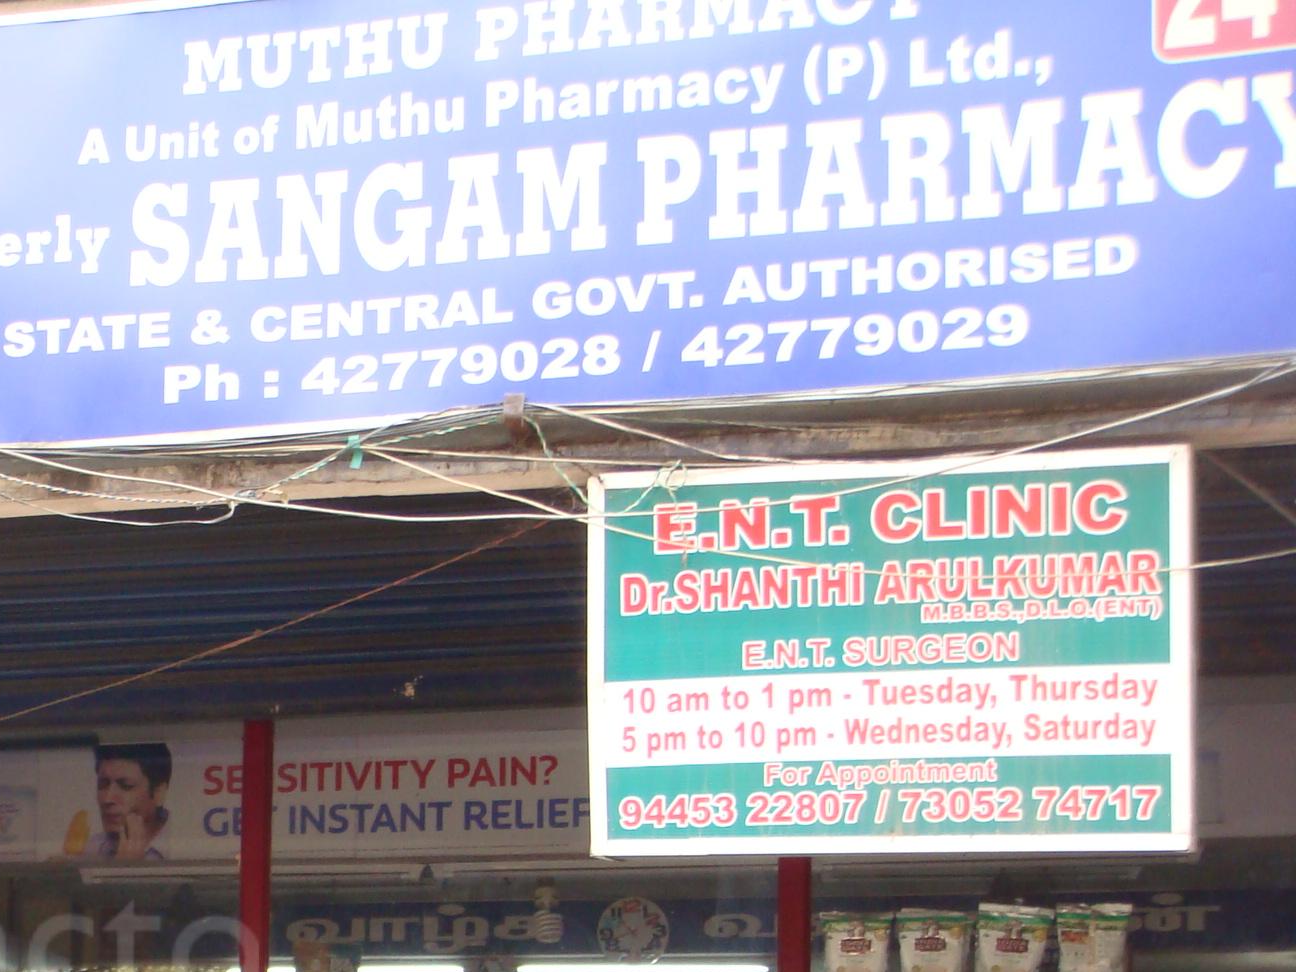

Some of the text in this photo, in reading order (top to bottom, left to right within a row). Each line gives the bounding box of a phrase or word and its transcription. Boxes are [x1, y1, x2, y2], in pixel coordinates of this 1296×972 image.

[182, 10, 448, 96] MUTHU
[78, 29, 1053, 165] A Unit of Muthu Pharmacy (P) Ltd.,
[129, 141, 607, 287] SANGAM
[3, 234, 1139, 358] STATE & CENTRAL GOVT. AUTHORISED
[163, 303, 1031, 404] Ph 42779028 42779029
[654, 480, 1128, 554] E.N.T. CLINIC
[620, 550, 1161, 616] Dr.SHANTHI ARULKUMAR
[742, 632, 1019, 670] E.N.T. SURGEON
[622, 674, 1158, 714] 10 am to 1 pm Tuesday, Thursday
[622, 713, 1157, 758] 5 pm to 10 pm Wednesday, Saturday
[204, 755, 559, 796] SESITIVITY PAIN?
[764, 757, 999, 790] For Appointment
[289, 801, 452, 835] INSTANT
[464, 798, 591, 831] RELIEF
[620, 783, 1161, 830] 94453 22807 73052 74717
